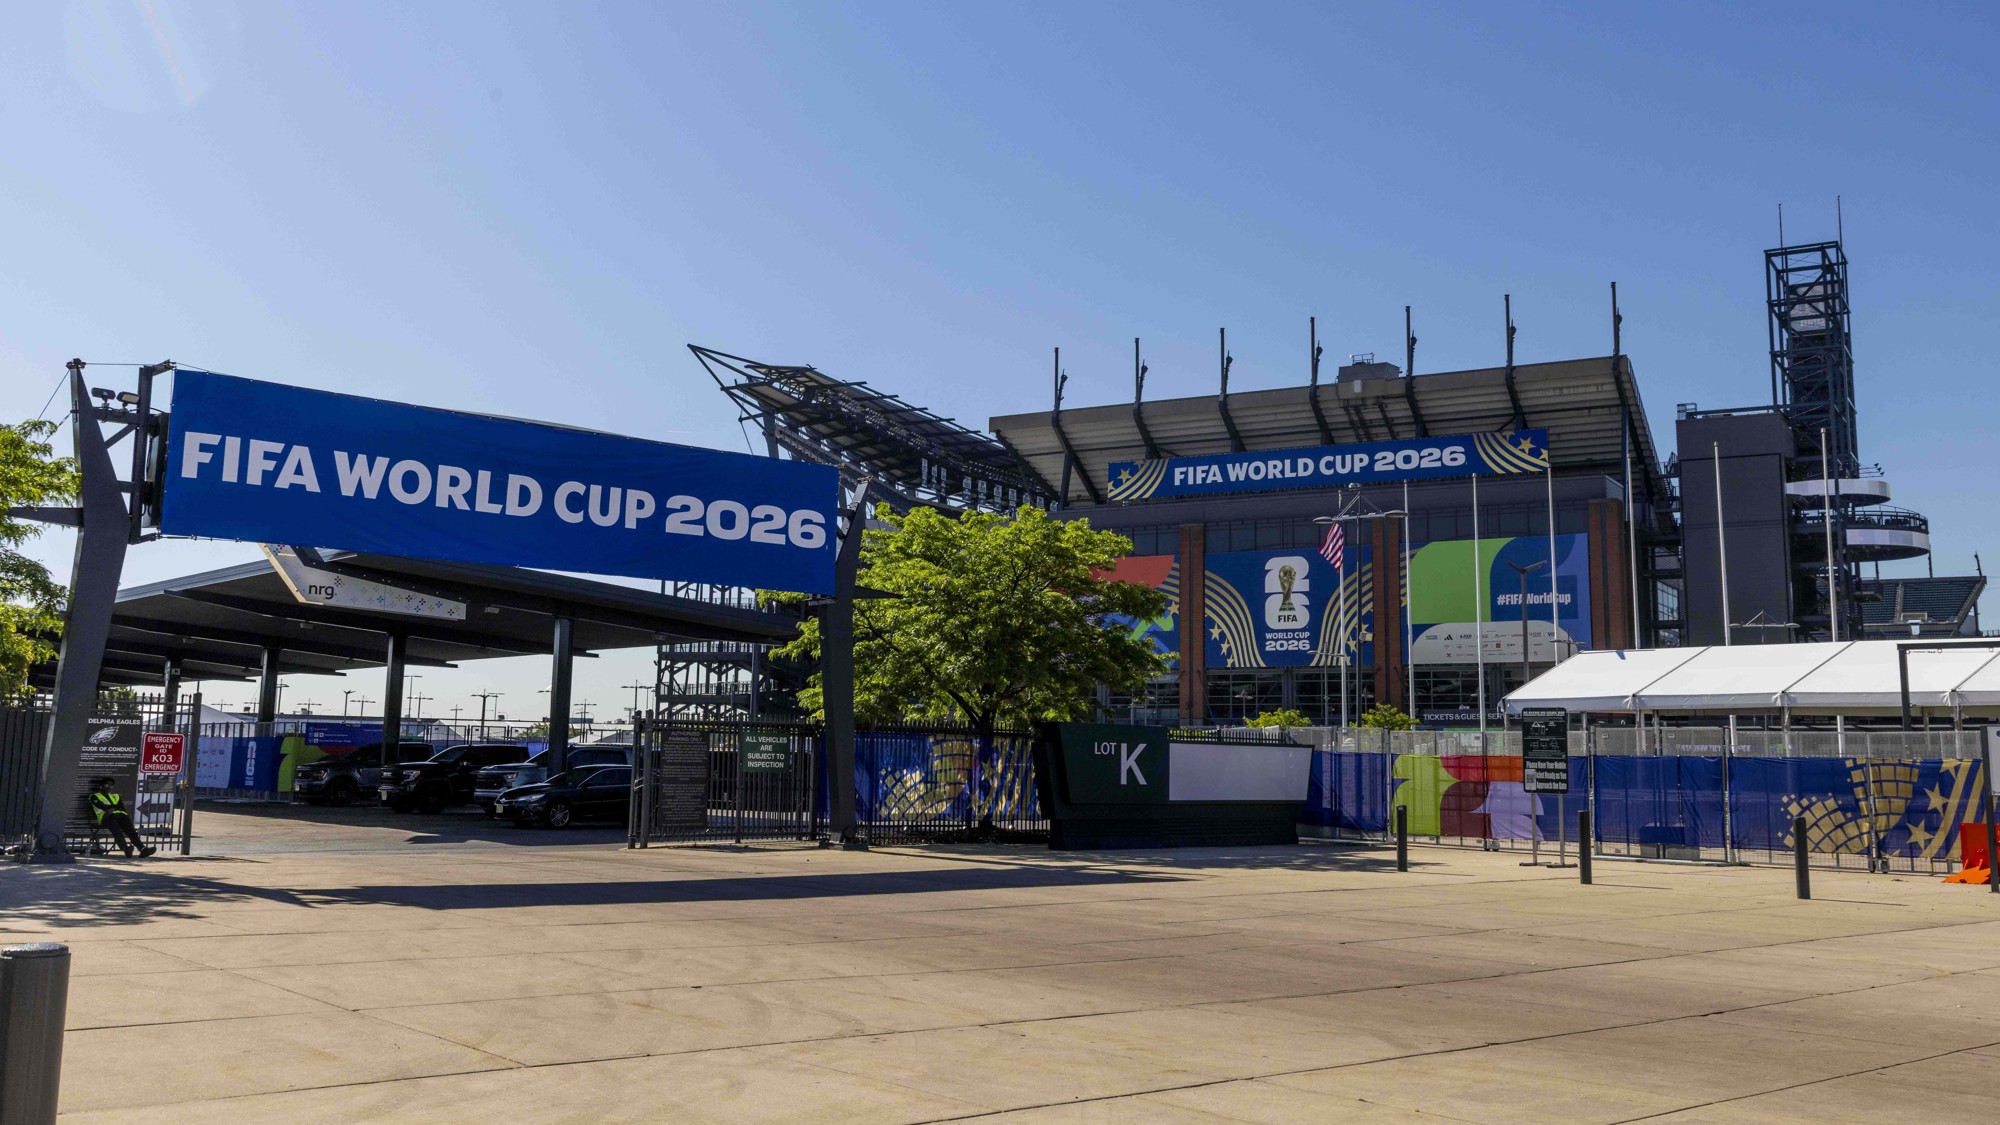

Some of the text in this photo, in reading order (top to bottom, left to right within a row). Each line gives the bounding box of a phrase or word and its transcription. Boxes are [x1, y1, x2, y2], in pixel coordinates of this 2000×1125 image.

[1174, 445, 1467, 486] FIFA WORLD CUP 2026
[181, 431, 827, 549] FIFA WORLD CUP 2026
[308, 584, 335, 600] nrg
[1277, 614, 1299, 623] FIFA
[1265, 631, 1310, 640] WORLD CUP
[1265, 640, 1311, 651] 2026
[1423, 713, 1454, 721] TICKETS
[144, 763, 178, 771] EMERGENCY
[1094, 742, 1148, 785] LOT K
[1526, 761, 1537, 769] Please
[1538, 761, 1546, 769] Have
[1546, 761, 1554, 769] Your
[1545, 772, 1555, 780] Ready
[1536, 781, 1552, 789] Approach
[1559, 782, 1567, 790] Gate
